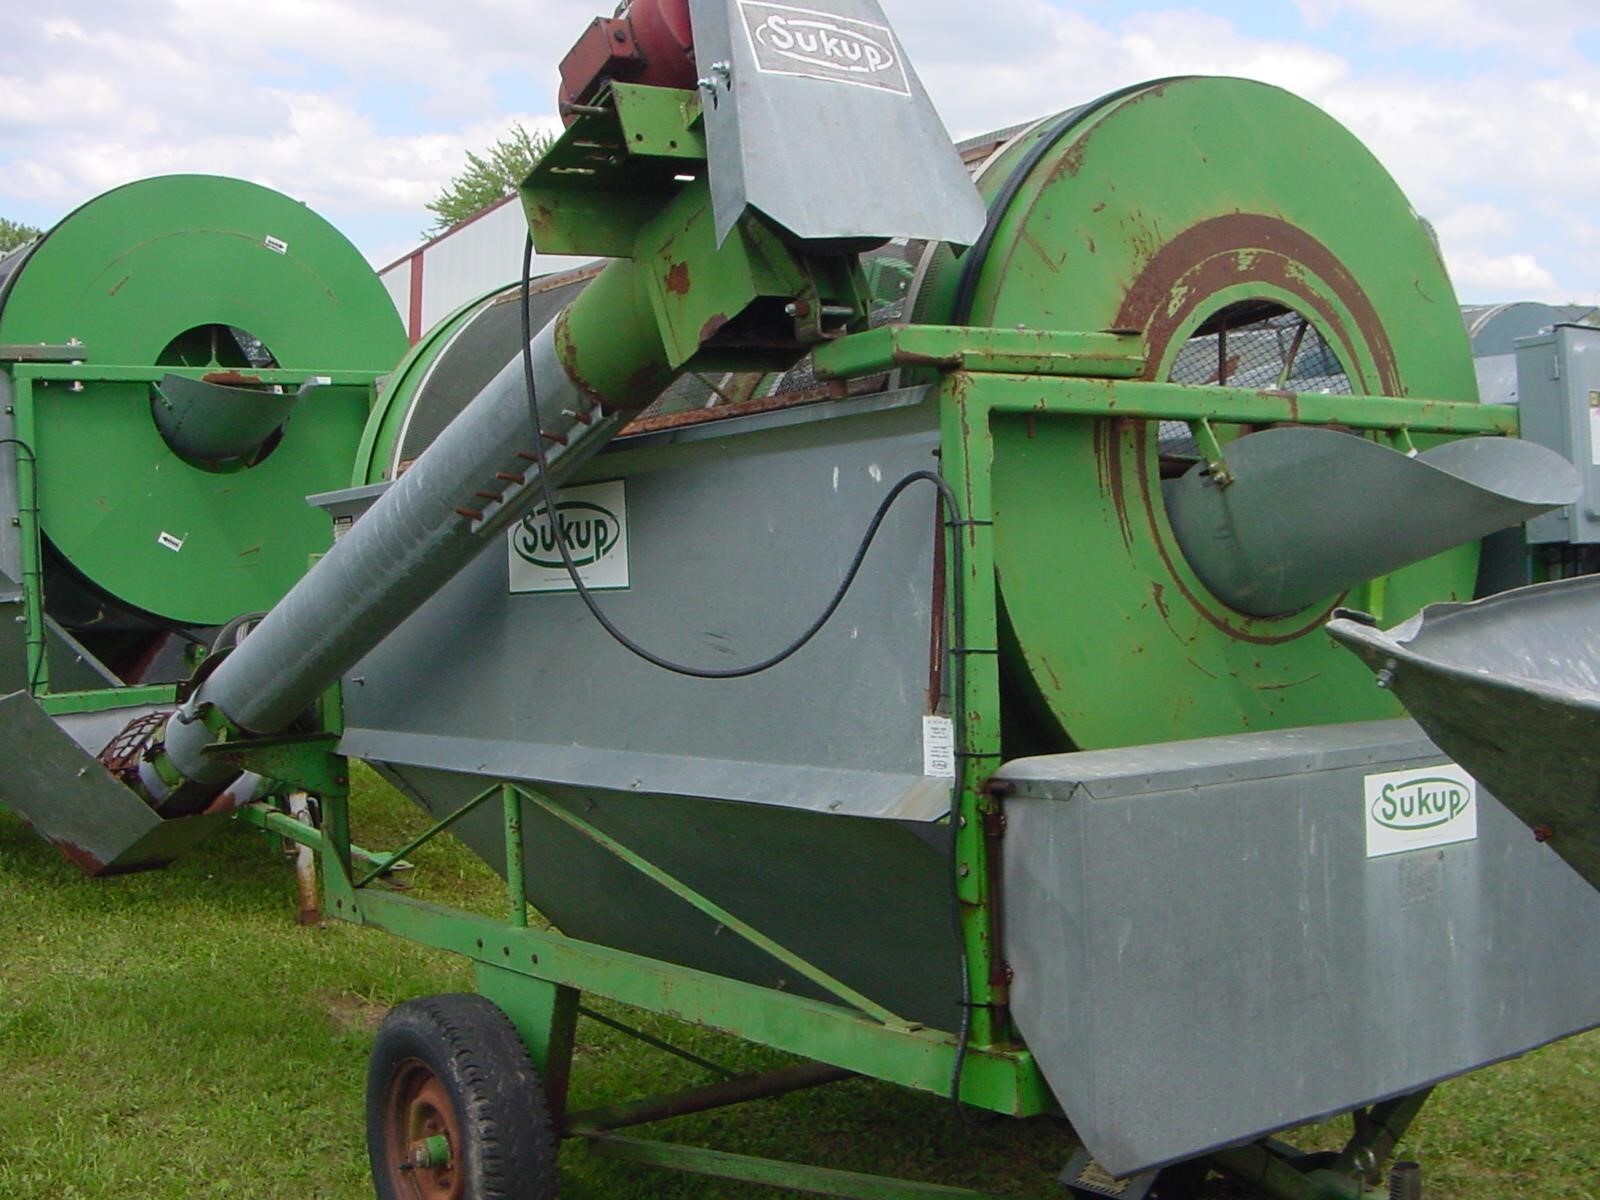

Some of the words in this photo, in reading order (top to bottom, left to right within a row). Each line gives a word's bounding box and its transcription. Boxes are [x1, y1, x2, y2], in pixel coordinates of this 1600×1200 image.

[767, 15, 881, 72] Sukup
[522, 505, 608, 561] Sukup
[1381, 783, 1461, 820] Sukup
